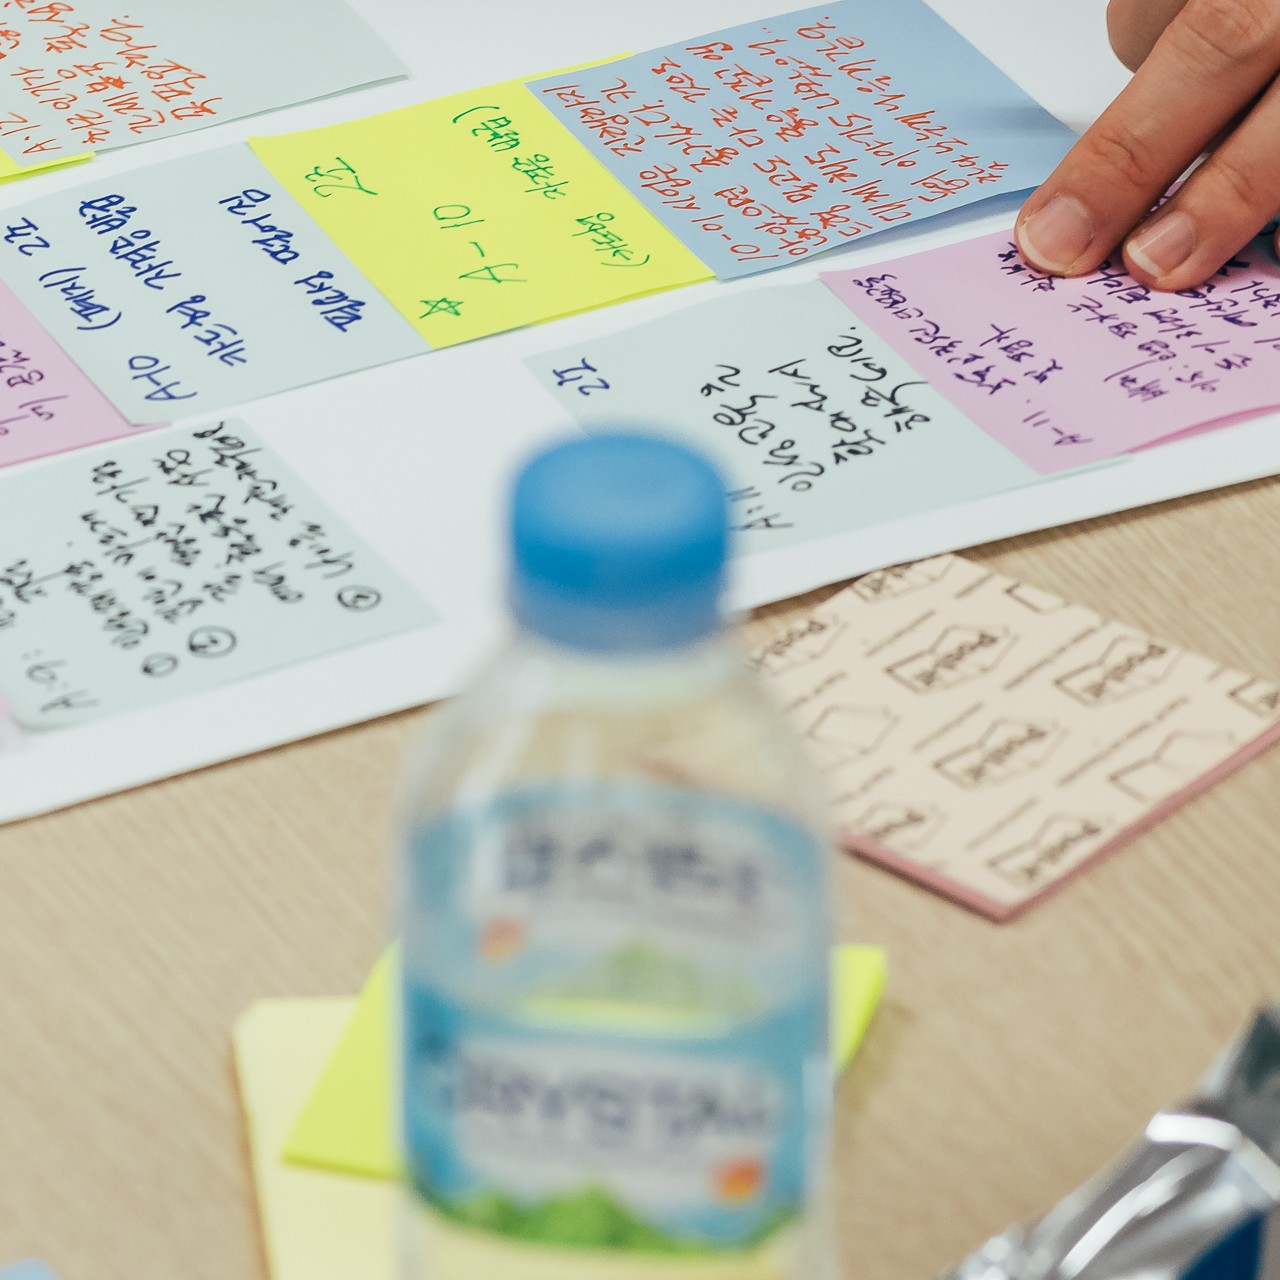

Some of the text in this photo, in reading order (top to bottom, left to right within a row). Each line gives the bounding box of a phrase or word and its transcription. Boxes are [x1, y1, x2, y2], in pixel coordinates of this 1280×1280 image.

[304, 156, 379, 199] 2조
[3, 216, 51, 257] 2조
[218, 188, 367, 333] 필요성 떨어짐
[165, 294, 247, 367] 카드형
